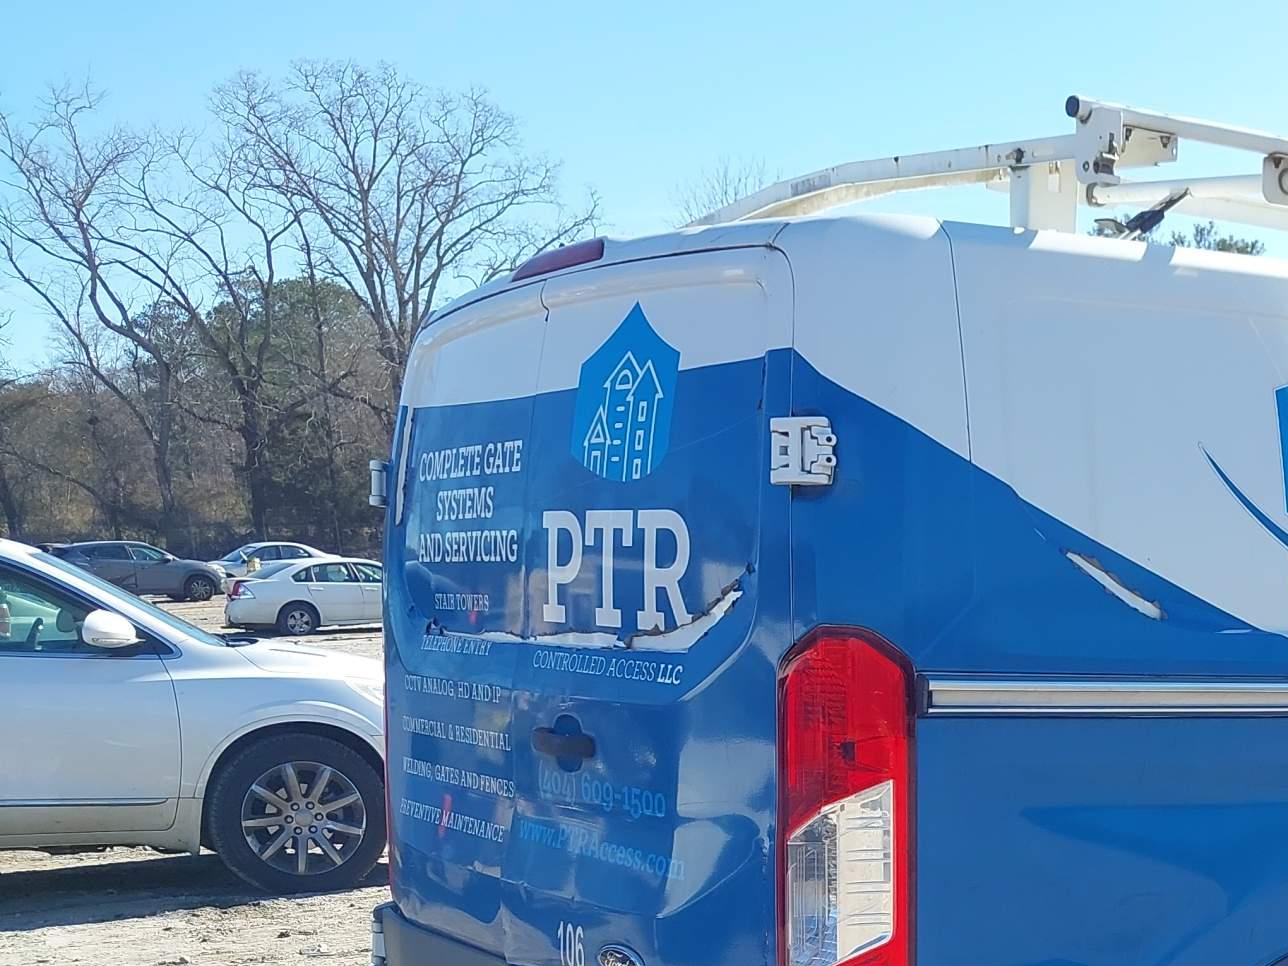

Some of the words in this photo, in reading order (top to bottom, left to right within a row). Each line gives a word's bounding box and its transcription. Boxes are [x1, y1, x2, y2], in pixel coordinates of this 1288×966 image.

[420, 445, 482, 482] COMPLETE
[484, 440, 522, 475] GATE
[437, 486, 494, 521] SYSTEMS
[419, 533, 443, 562] AND
[445, 529, 518, 562] SERVICING
[543, 508, 692, 630] PTR
[457, 593, 489, 612] TOWERS
[463, 640, 493, 655] ENTRY
[533, 650, 606, 675] CONTROLLED
[607, 658, 657, 681] ACCESS
[657, 664, 683, 685] LLC
[404, 675, 421, 691] CCTV
[458, 682, 470, 699] HD
[472, 684, 491, 702] AND
[493, 686, 501, 703] IP
[402, 715, 446, 739] COMMERCIAL
[456, 725, 512, 751] RESIDENTIAL
[434, 765, 459, 785] GATES
[460, 770, 479, 789] AND
[480, 775, 515, 798] FENCES
[538, 759, 577, 805] (404)
[581, 772, 666, 819] 609-1500
[441, 810, 505, 843] MAINTENANCE
[519, 819, 686, 880] www.PTRAccess.com
